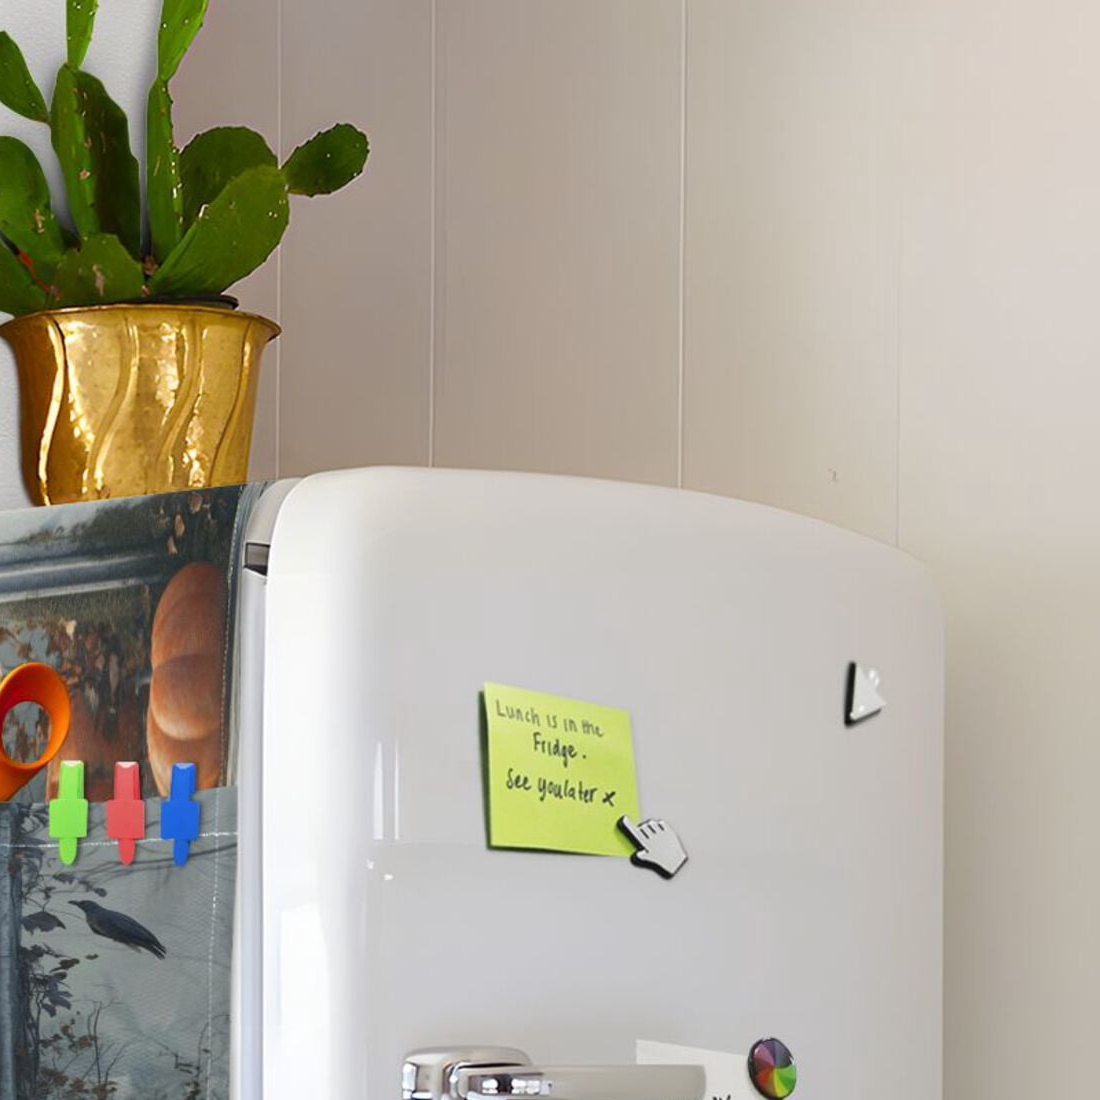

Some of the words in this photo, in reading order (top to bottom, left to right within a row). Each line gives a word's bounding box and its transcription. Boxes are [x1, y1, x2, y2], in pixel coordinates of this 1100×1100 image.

[495, 699, 541, 728] Lunch
[546, 714, 557, 729] is
[563, 717, 578, 733] in
[582, 719, 604, 738] the
[506, 768, 532, 791] See
